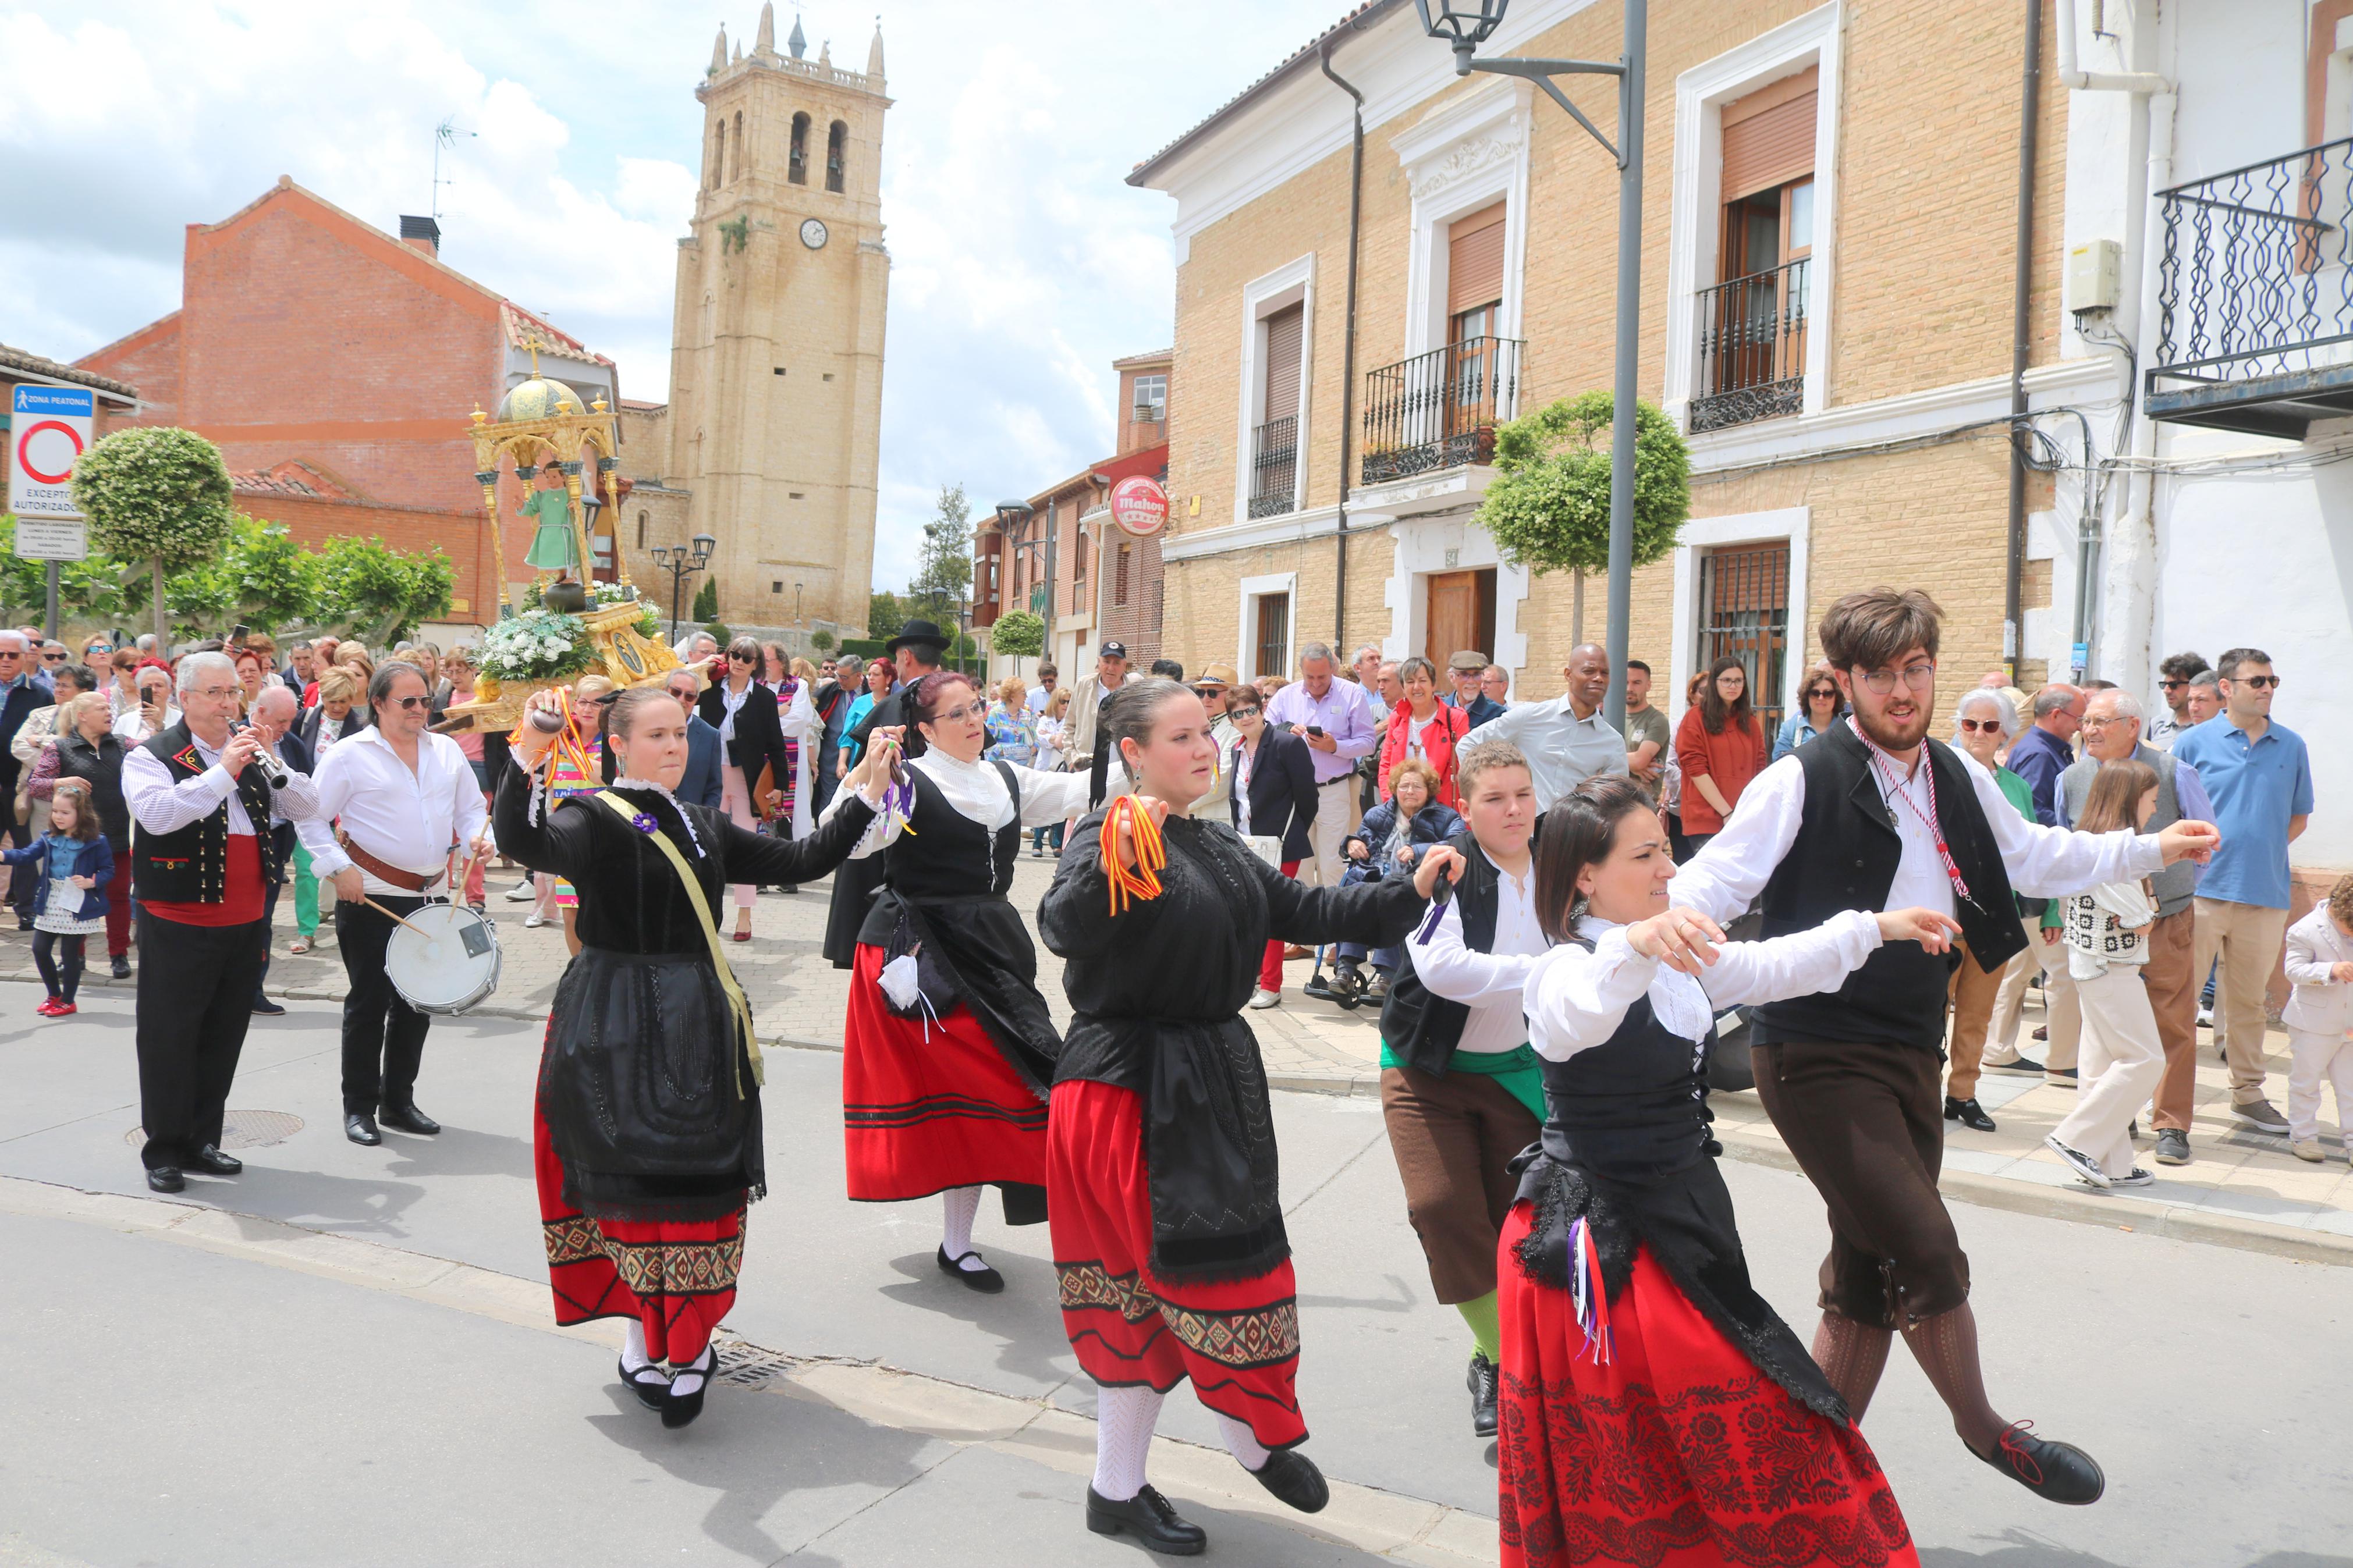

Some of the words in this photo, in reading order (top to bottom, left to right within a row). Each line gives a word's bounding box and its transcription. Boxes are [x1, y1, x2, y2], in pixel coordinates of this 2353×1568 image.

[28, 396, 49, 404] ZONA
[51, 396, 90, 406] PEATONAL
[14, 500, 77, 511] AUTORIZADO
[1120, 497, 1165, 511] Mahou
